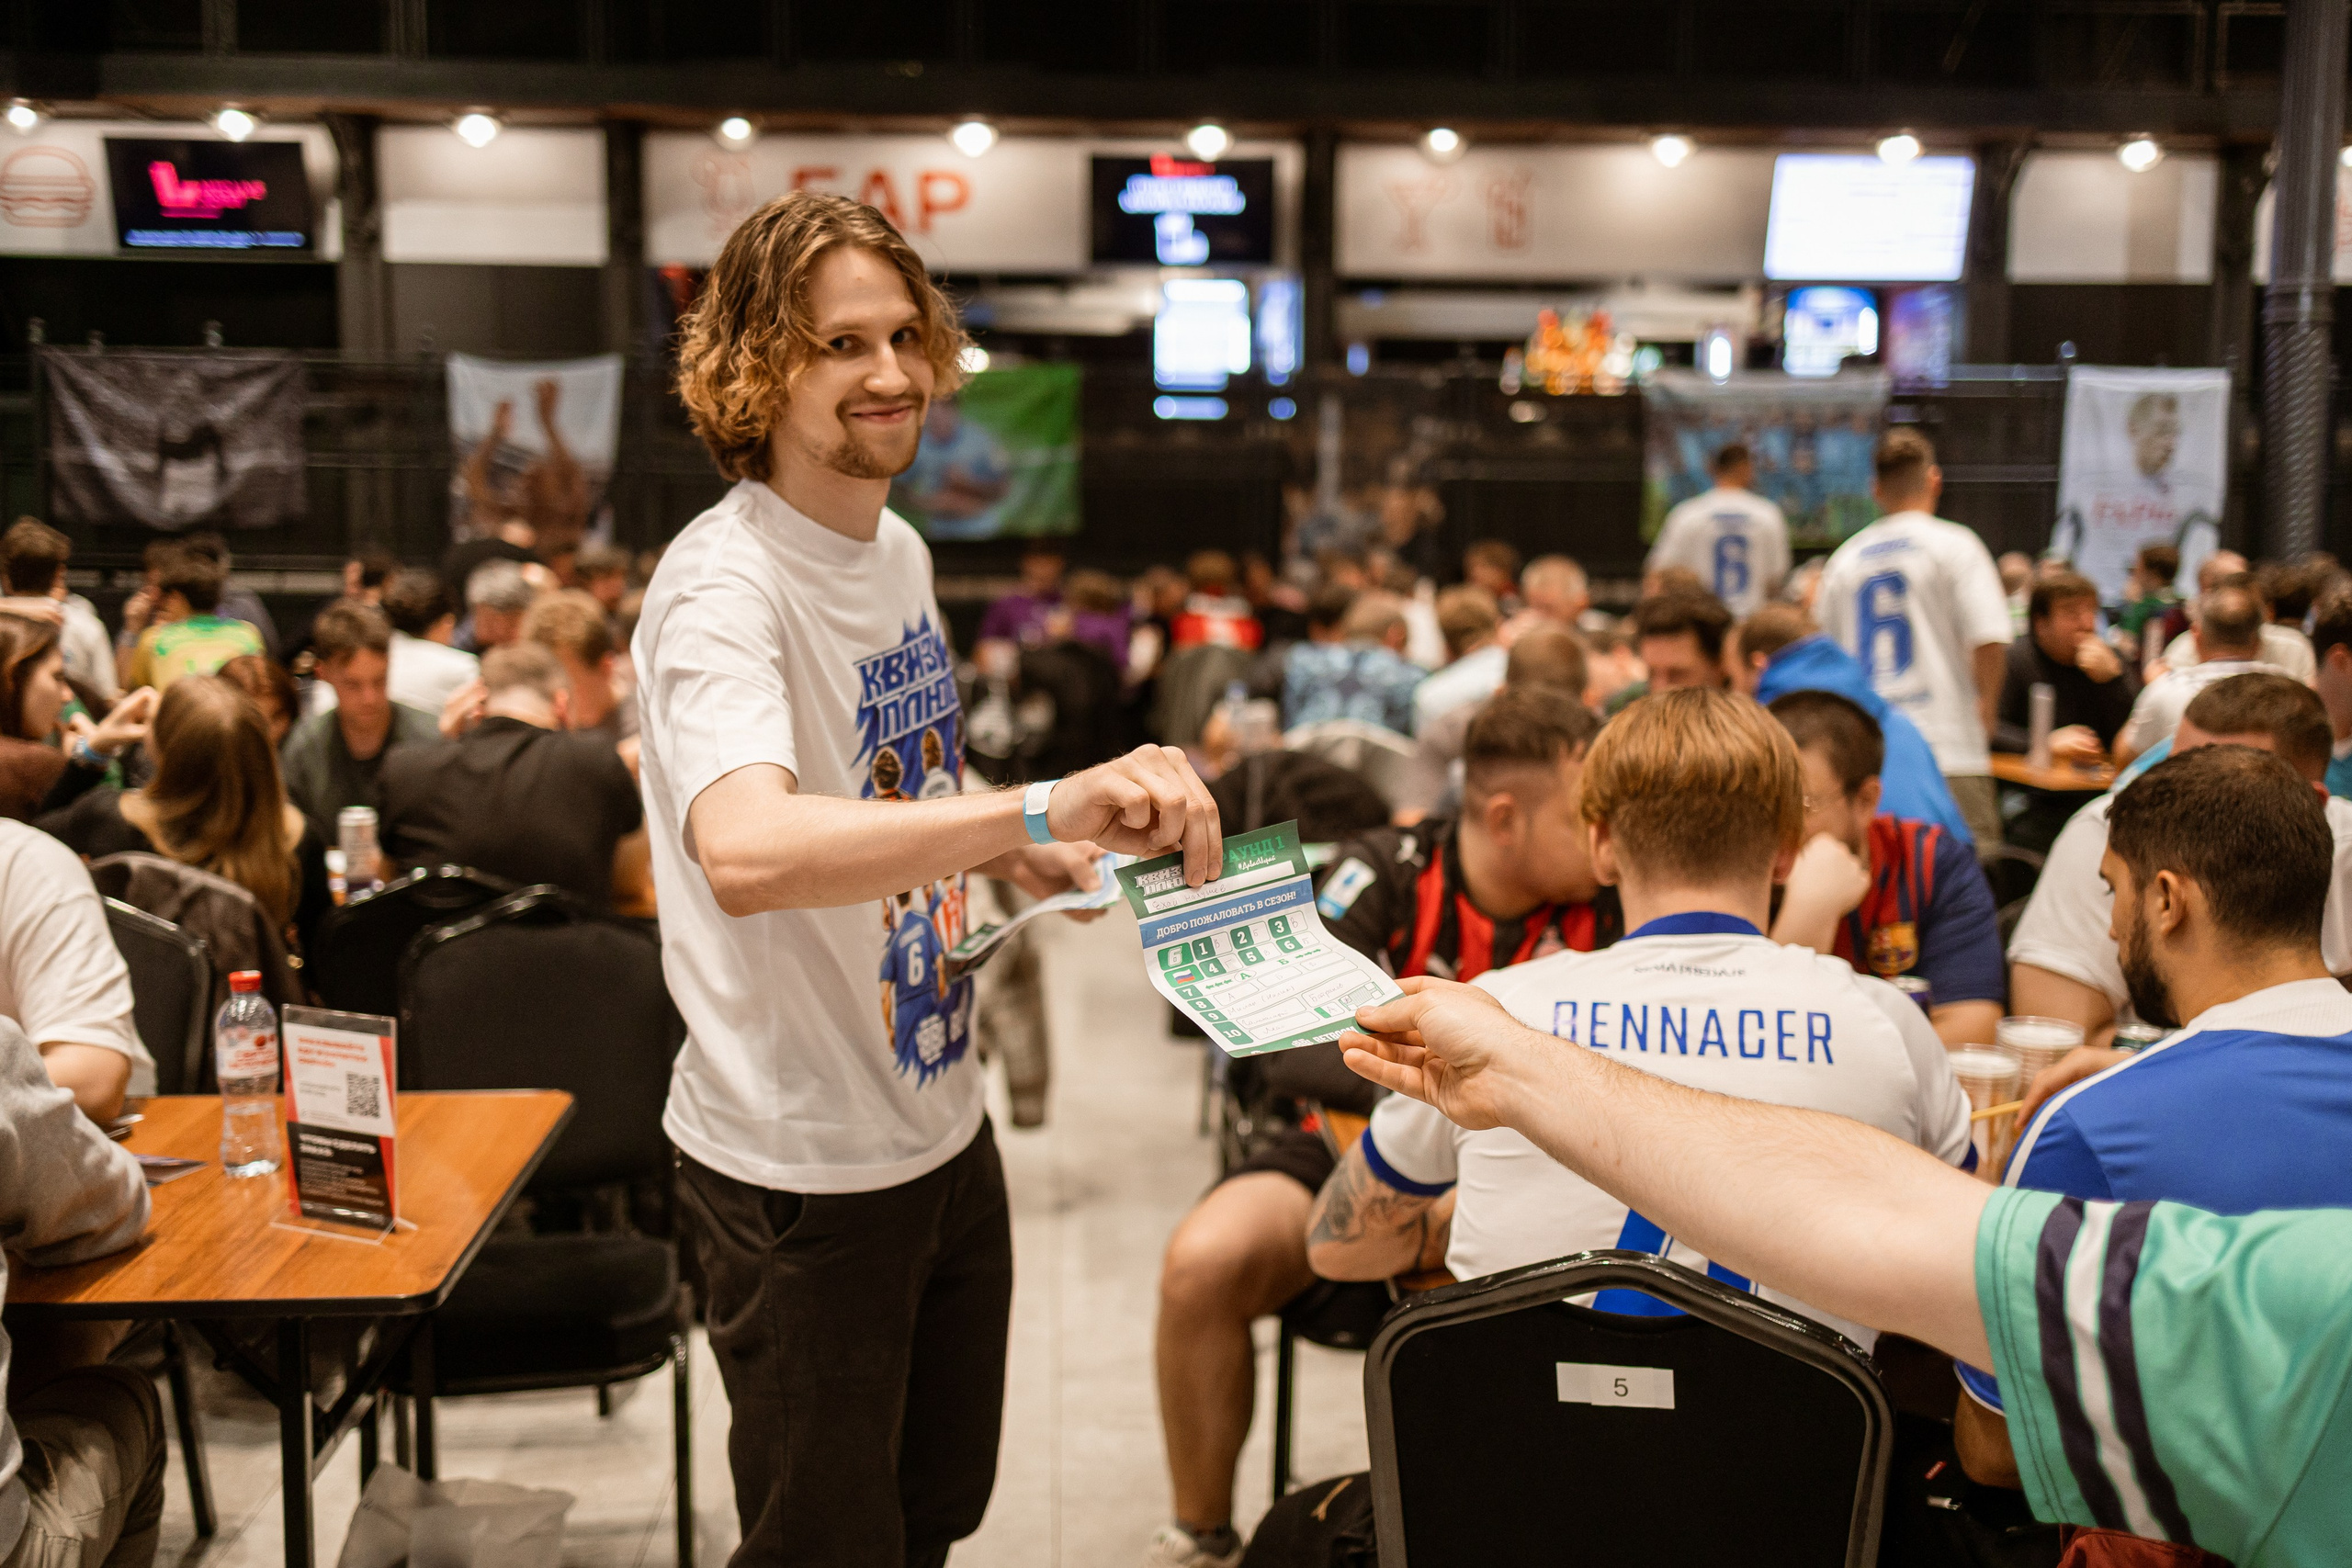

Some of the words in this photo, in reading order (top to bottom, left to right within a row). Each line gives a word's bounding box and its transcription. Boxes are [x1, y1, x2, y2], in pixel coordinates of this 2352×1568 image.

[1713, 535, 1749, 601] 6
[1855, 570, 1913, 680] 6
[1274, 835, 1285, 850] 1
[1135, 864, 1183, 888] КВИЗ
[1143, 875, 1187, 897] ПЛЮ
[1156, 920, 1189, 940] ДОБРО
[1189, 903, 1256, 930] ПОЖАЛОВАТЬ
[1256, 899, 1264, 910] В
[1264, 891, 1297, 908] СЕЗОН!
[1274, 920, 1284, 933] 3
[1237, 931, 1248, 945] 2
[1198, 942, 1208, 956] 1
[1283, 940, 1295, 951] 6
[1245, 951, 1258, 963] 5
[908, 942, 925, 987] 6
[1208, 963, 1219, 974] 4
[1182, 987, 1193, 997] 7
[1195, 1000, 1207, 1009] 8
[1207, 1012, 1220, 1021] 9
[1223, 1028, 1242, 1039] 10
[1553, 1000, 1835, 1066] BENNACER
[1613, 1378, 1629, 1397] 5
